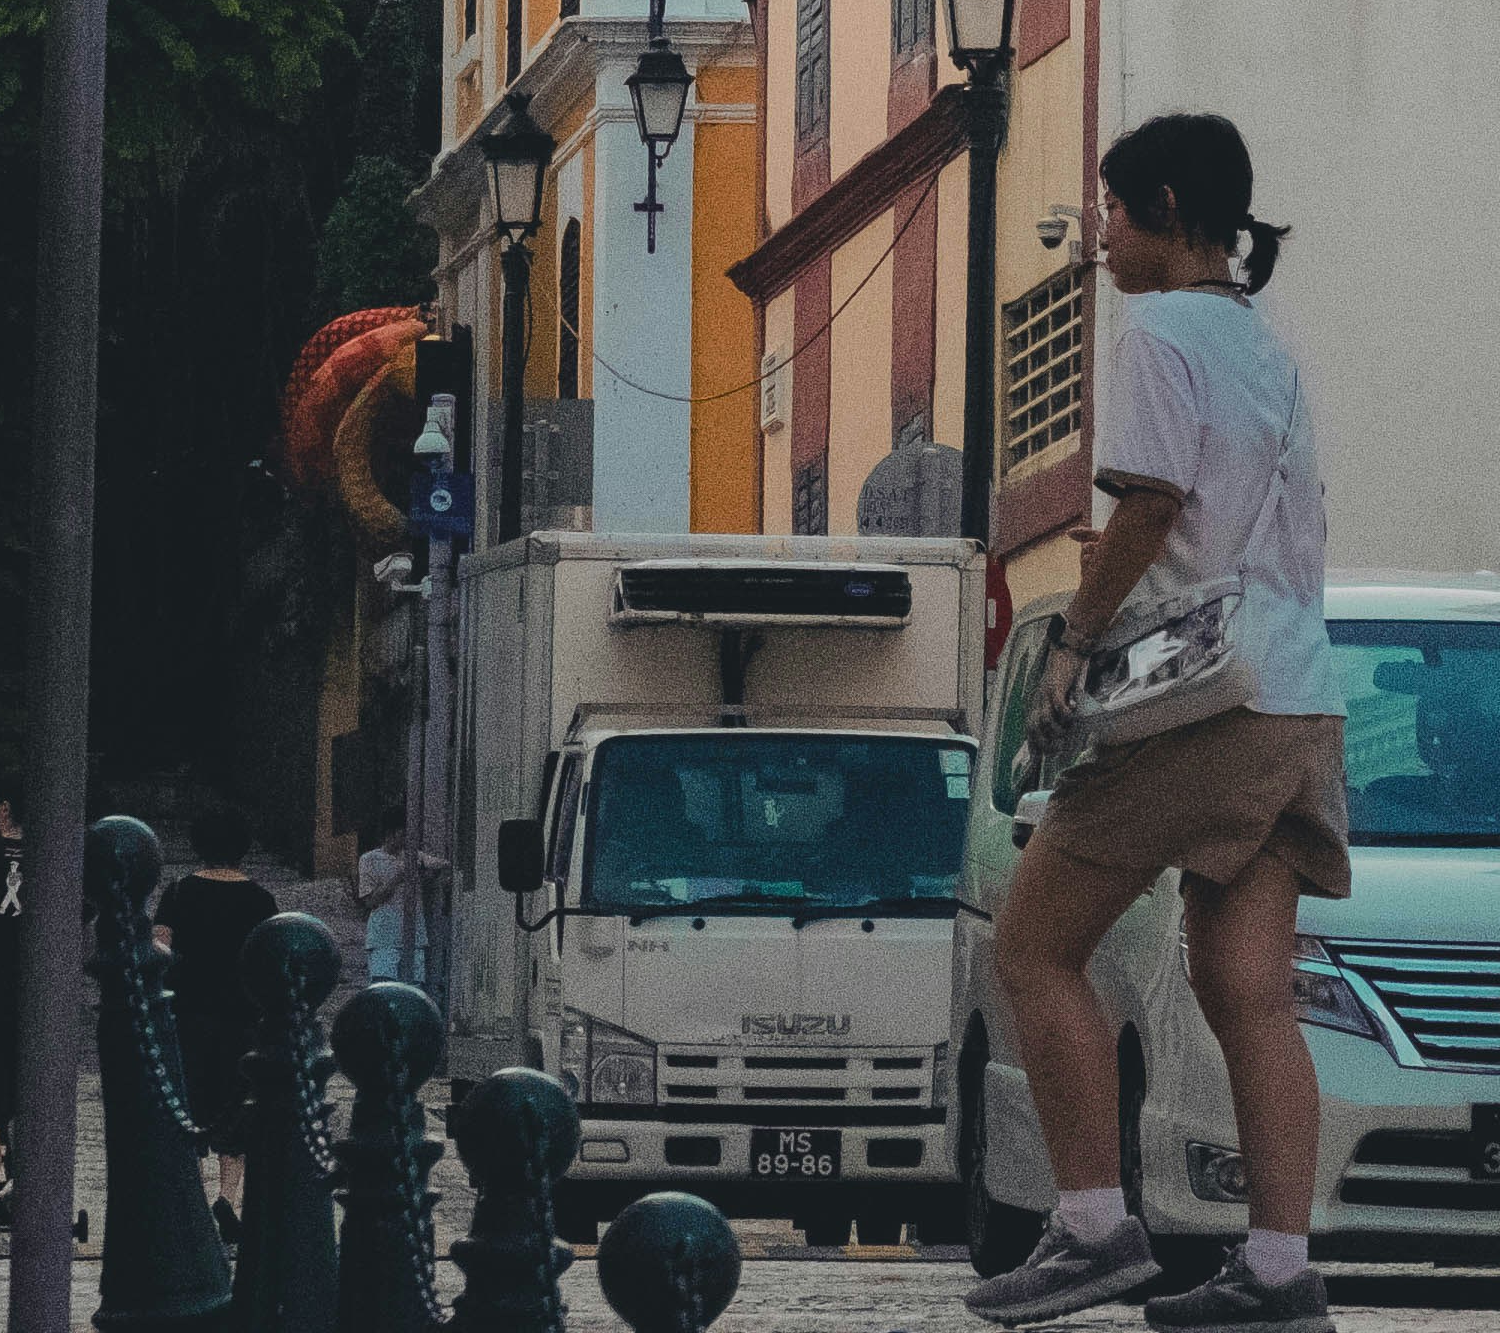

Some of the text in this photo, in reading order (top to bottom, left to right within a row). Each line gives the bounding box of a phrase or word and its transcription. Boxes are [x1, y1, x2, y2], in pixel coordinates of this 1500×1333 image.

[740, 1013, 852, 1036] ISUZU
[779, 1131, 812, 1154] MS
[757, 1152, 833, 1176] 89-86
